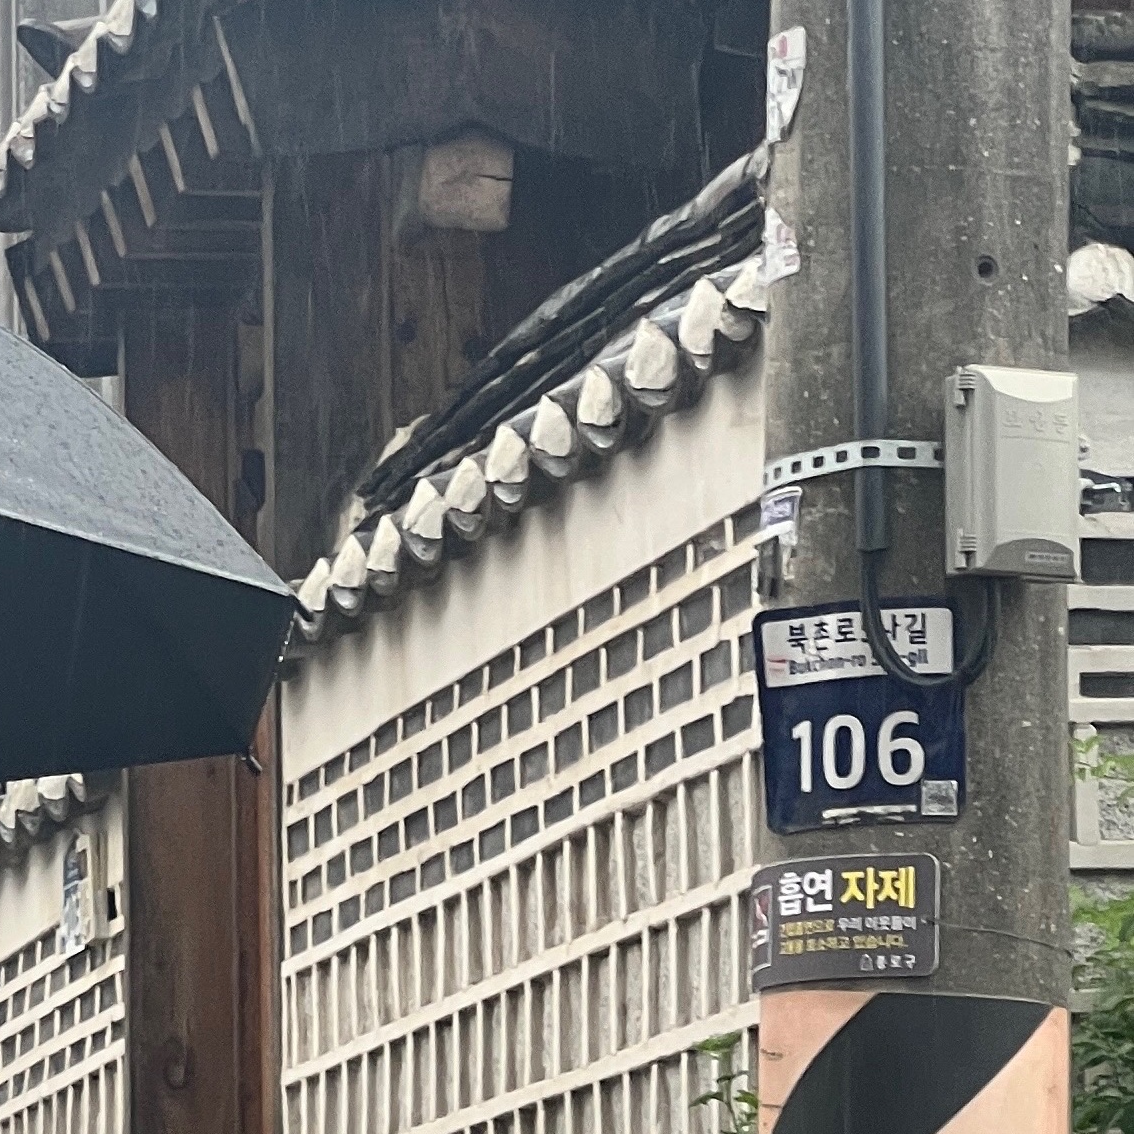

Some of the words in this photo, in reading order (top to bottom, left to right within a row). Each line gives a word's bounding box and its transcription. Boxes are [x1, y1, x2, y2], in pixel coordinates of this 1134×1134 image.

[792, 710, 926, 793] 106
[777, 868, 833, 916] 흡연
[840, 866, 916, 909] 자제
